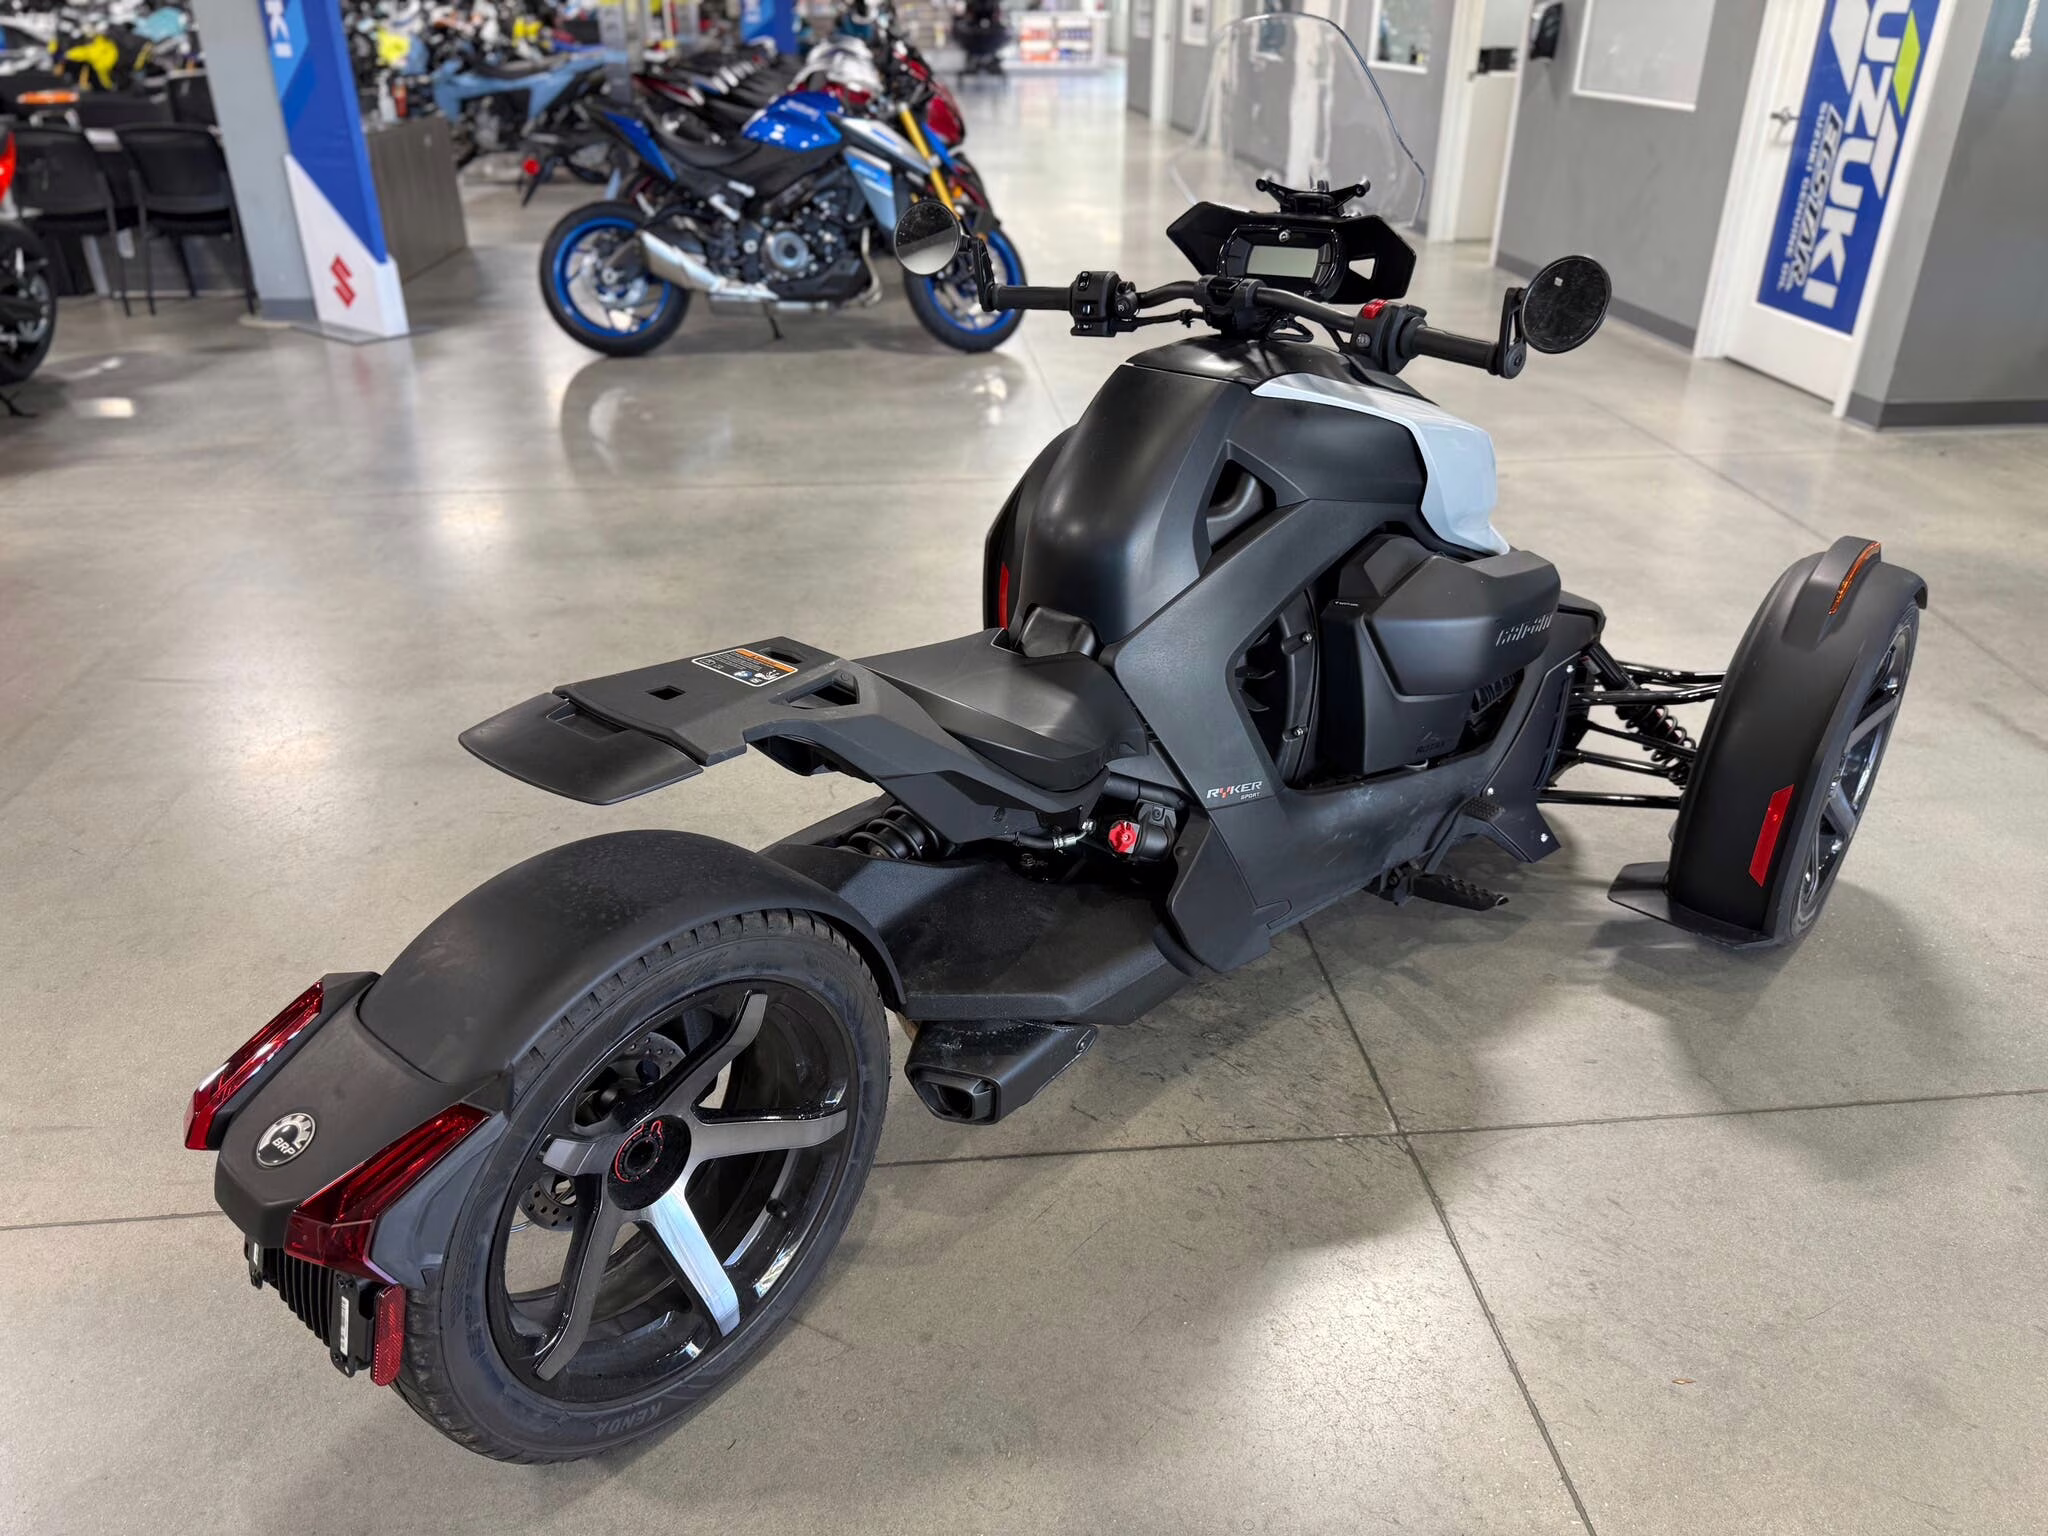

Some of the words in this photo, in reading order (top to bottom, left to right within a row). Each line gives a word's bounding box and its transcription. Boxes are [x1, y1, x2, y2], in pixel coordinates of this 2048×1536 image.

[1206, 780, 1263, 800] RYKER
[1240, 791, 1261, 800] SPORT
[272, 1136, 296, 1155] BRP
[596, 1401, 662, 1437] KENDA
